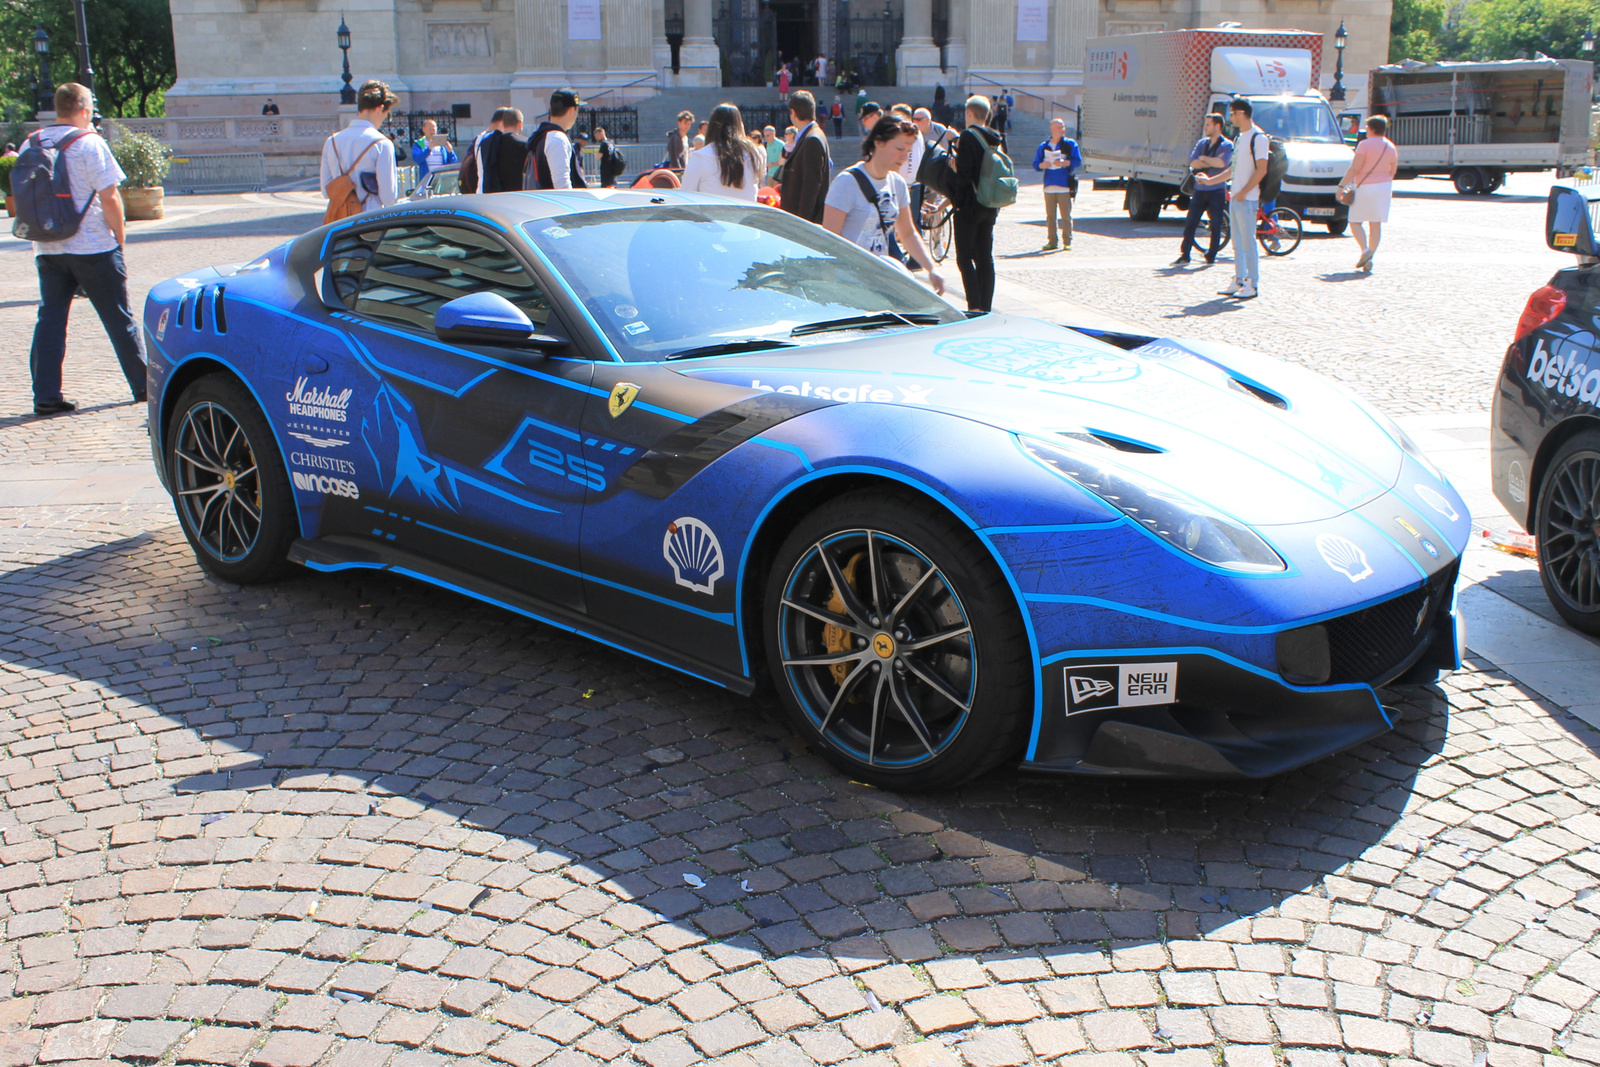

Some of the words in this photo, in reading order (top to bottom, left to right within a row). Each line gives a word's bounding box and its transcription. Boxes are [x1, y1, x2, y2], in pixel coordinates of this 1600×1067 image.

[1091, 51, 1114, 61] EVENT
[1090, 62, 1114, 72] STUFF
[400, 209, 454, 217] STAPLETON
[1527, 339, 1600, 408] betsa
[286, 376, 352, 409] Marshall
[289, 402, 347, 422] HEADPHONES
[286, 422, 350, 436] JETSMARTER
[291, 451, 356, 476] CHRISTIE'S
[528, 439, 606, 491] 25
[1128, 672, 1168, 685] NEW
[1127, 684, 1168, 697] ERA
